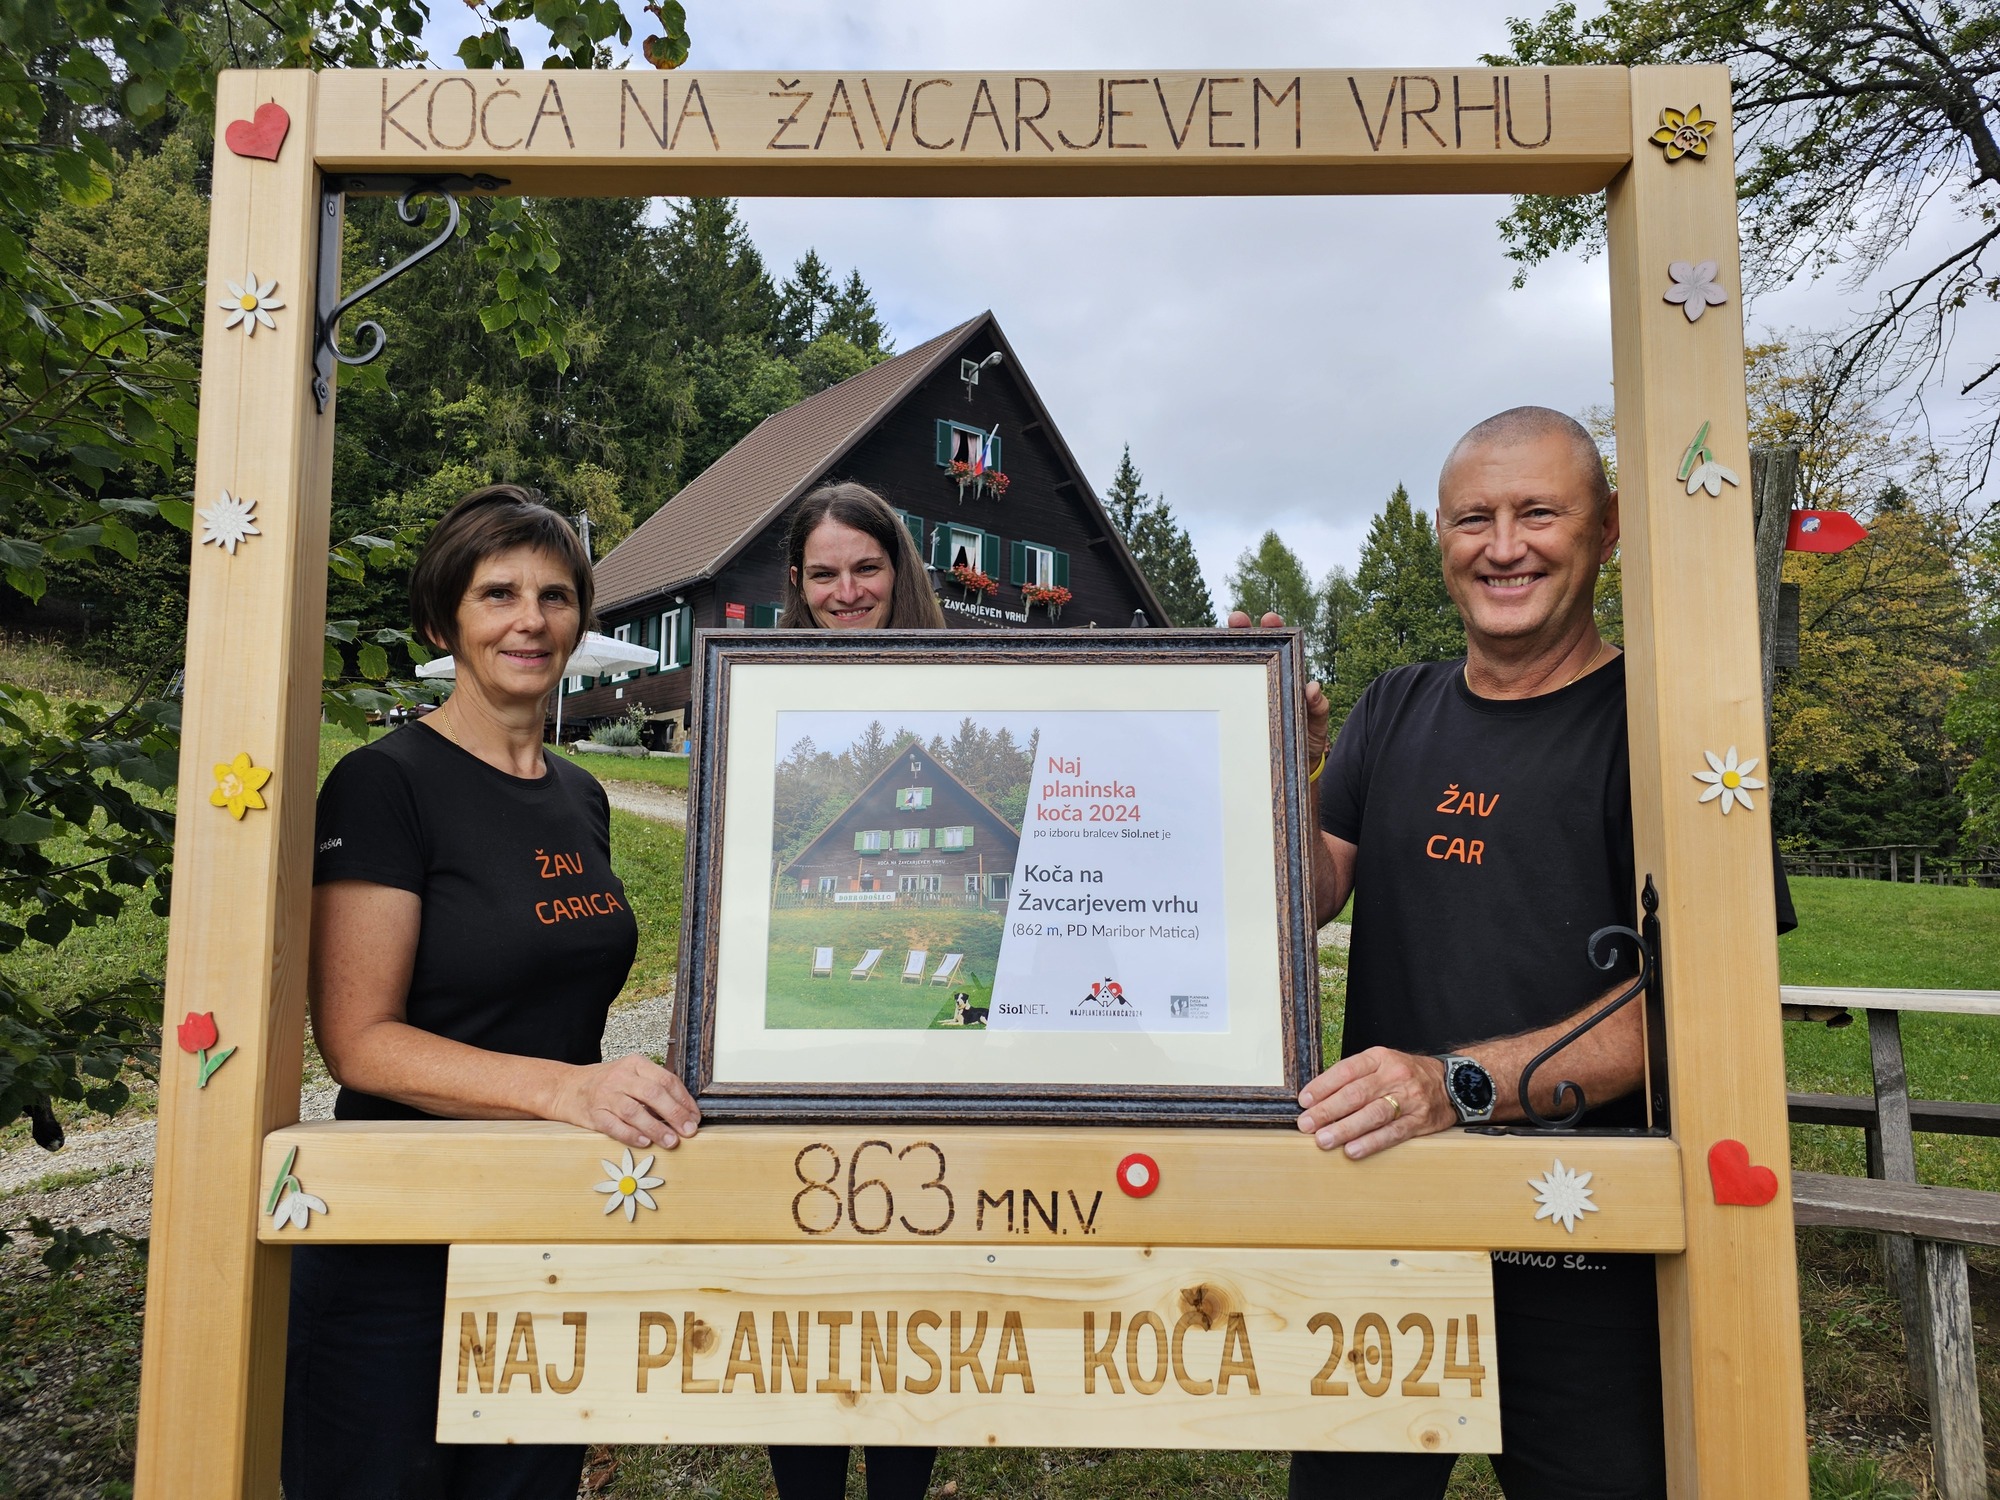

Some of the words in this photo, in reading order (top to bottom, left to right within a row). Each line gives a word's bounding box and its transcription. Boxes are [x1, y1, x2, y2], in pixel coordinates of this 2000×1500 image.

[380, 77, 575, 151] KOČA
[618, 77, 722, 151] NA
[765, 76, 1302, 153] ŽAVCARJEVEM
[1346, 74, 1552, 152] VRHU
[1004, 610, 1028, 624] VRHU
[1048, 756, 1081, 777] Naj
[1042, 780, 1136, 801] planinska
[1436, 783, 1500, 817] ŽAV
[1037, 803, 1083, 821] koča
[1089, 804, 1141, 822] 2024
[1033, 829, 1046, 839] po
[1049, 828, 1080, 838] izboru
[1083, 828, 1119, 838] bralcev
[1121, 828, 1160, 839] Siol.net
[1162, 829, 1172, 841] je
[1426, 834, 1485, 865] CAR
[534, 848, 583, 879] ŽAV
[1024, 864, 1074, 883] Koča
[1080, 869, 1104, 883] na
[534, 891, 624, 925] CARICA
[1018, 888, 1147, 915] Žavcarjevem
[1152, 895, 1199, 914] vrhu
[1012, 923, 1043, 938] (862
[1047, 926, 1063, 938] m,
[1067, 924, 1088, 937] PD
[1092, 924, 1146, 938] Maribor
[1150, 925, 1200, 940] Matica)
[791, 1139, 956, 1236] 863
[1562, 1254, 1608, 1271] se...
[456, 1311, 588, 1395] NAJ
[635, 1309, 1035, 1395] PLANINSKA
[1082, 1287, 1262, 1397] KOČA
[1305, 1311, 1487, 1398] 2024
